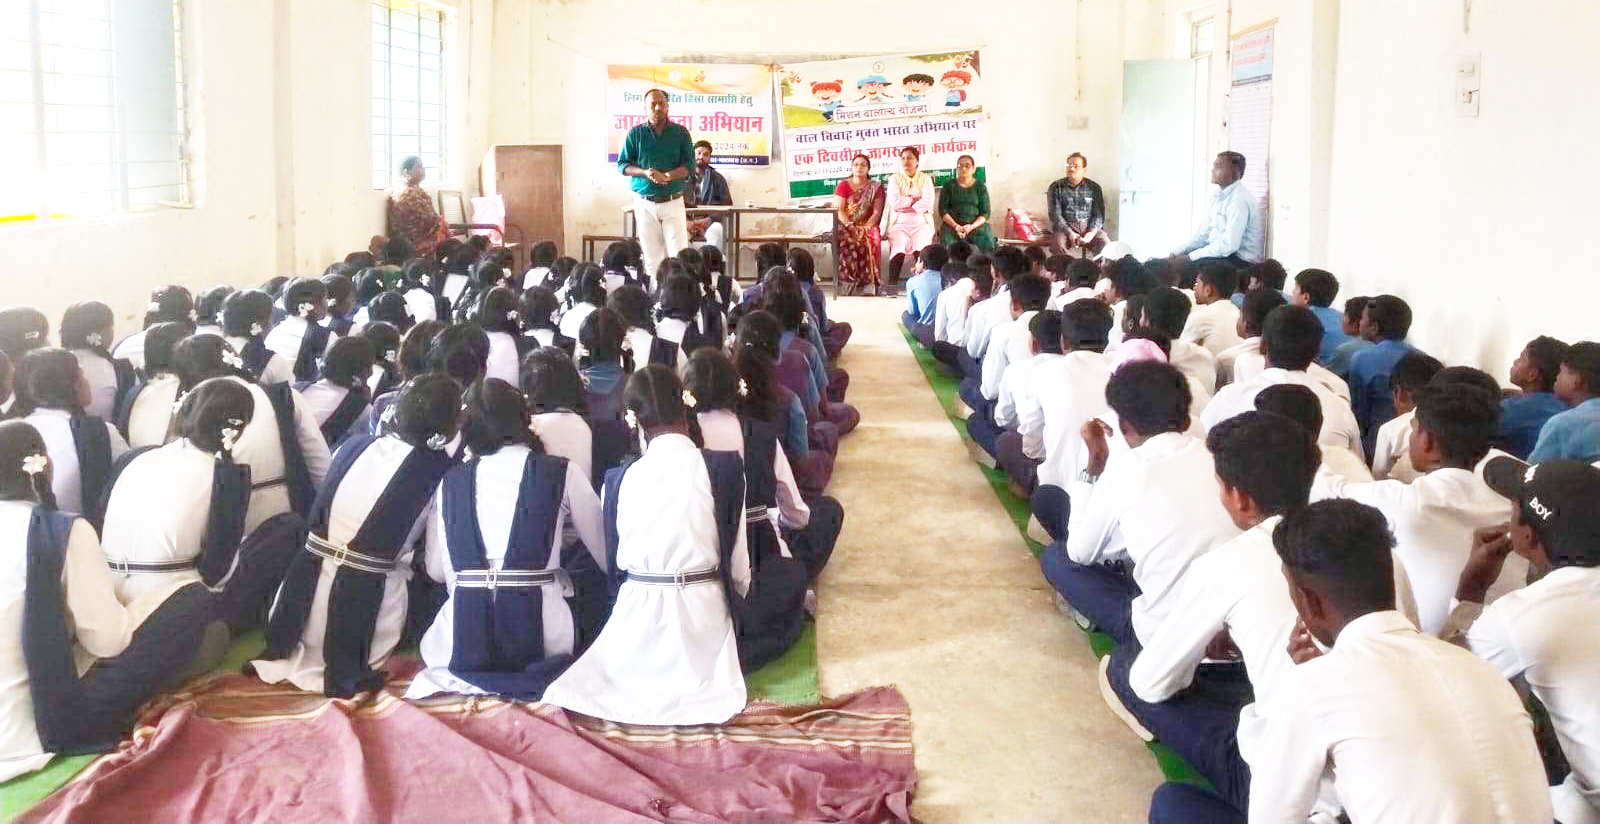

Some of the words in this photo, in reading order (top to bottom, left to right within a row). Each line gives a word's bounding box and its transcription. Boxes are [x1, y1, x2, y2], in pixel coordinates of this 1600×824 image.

[740, 92, 754, 107] हेतु
[699, 111, 764, 133] अभियान
[836, 108, 861, 121] मिशन
[899, 104, 928, 115] योजना
[795, 133, 818, 144] बाल
[821, 129, 853, 142] विवाह
[883, 125, 910, 137] भारत
[913, 120, 959, 134] अभियान
[963, 119, 977, 129] पर
[794, 153, 814, 165] एक
[866, 145, 927, 160] जागरूता
[931, 137, 977, 154] कार्यक्रम
[1529, 496, 1553, 521] BOY
